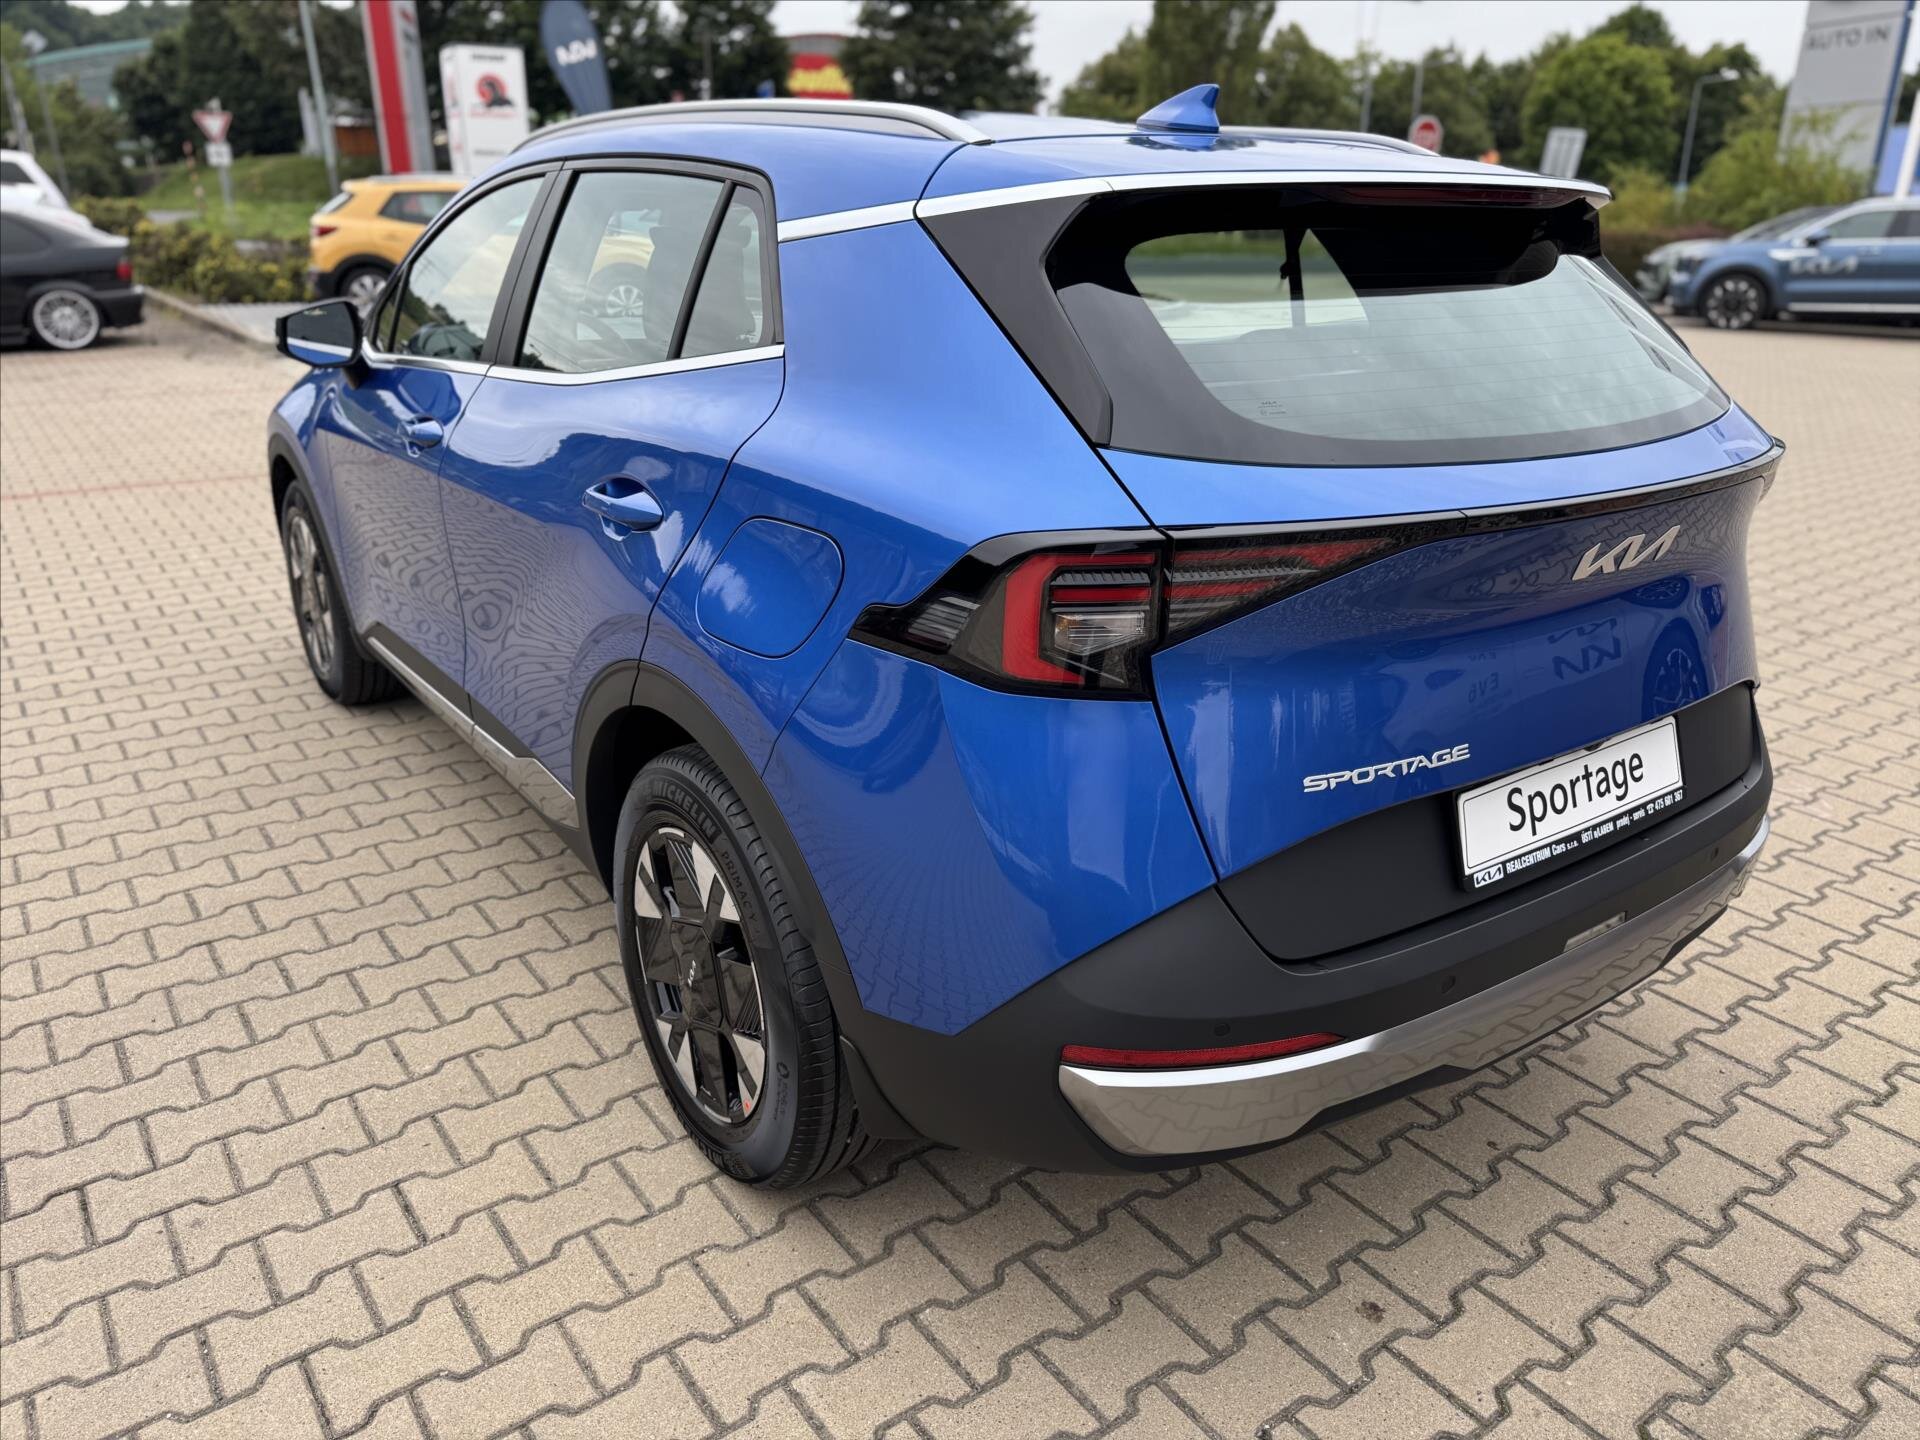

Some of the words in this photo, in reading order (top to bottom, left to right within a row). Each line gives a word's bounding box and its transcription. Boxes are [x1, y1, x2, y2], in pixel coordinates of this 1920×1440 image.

[1808, 27, 1861, 50] AUTO
[1865, 25, 1890, 45] IN
[1571, 524, 1681, 582] KIA
[1303, 743, 1471, 793] SPORTAGE
[1507, 752, 1645, 837] Sportage
[652, 780, 718, 841] MICHELIN
[721, 851, 759, 923] PRIMACY
[1475, 867, 1502, 886] KIA
[1506, 847, 1552, 874] REALCENTRUM
[1551, 843, 1566, 856] Cars
